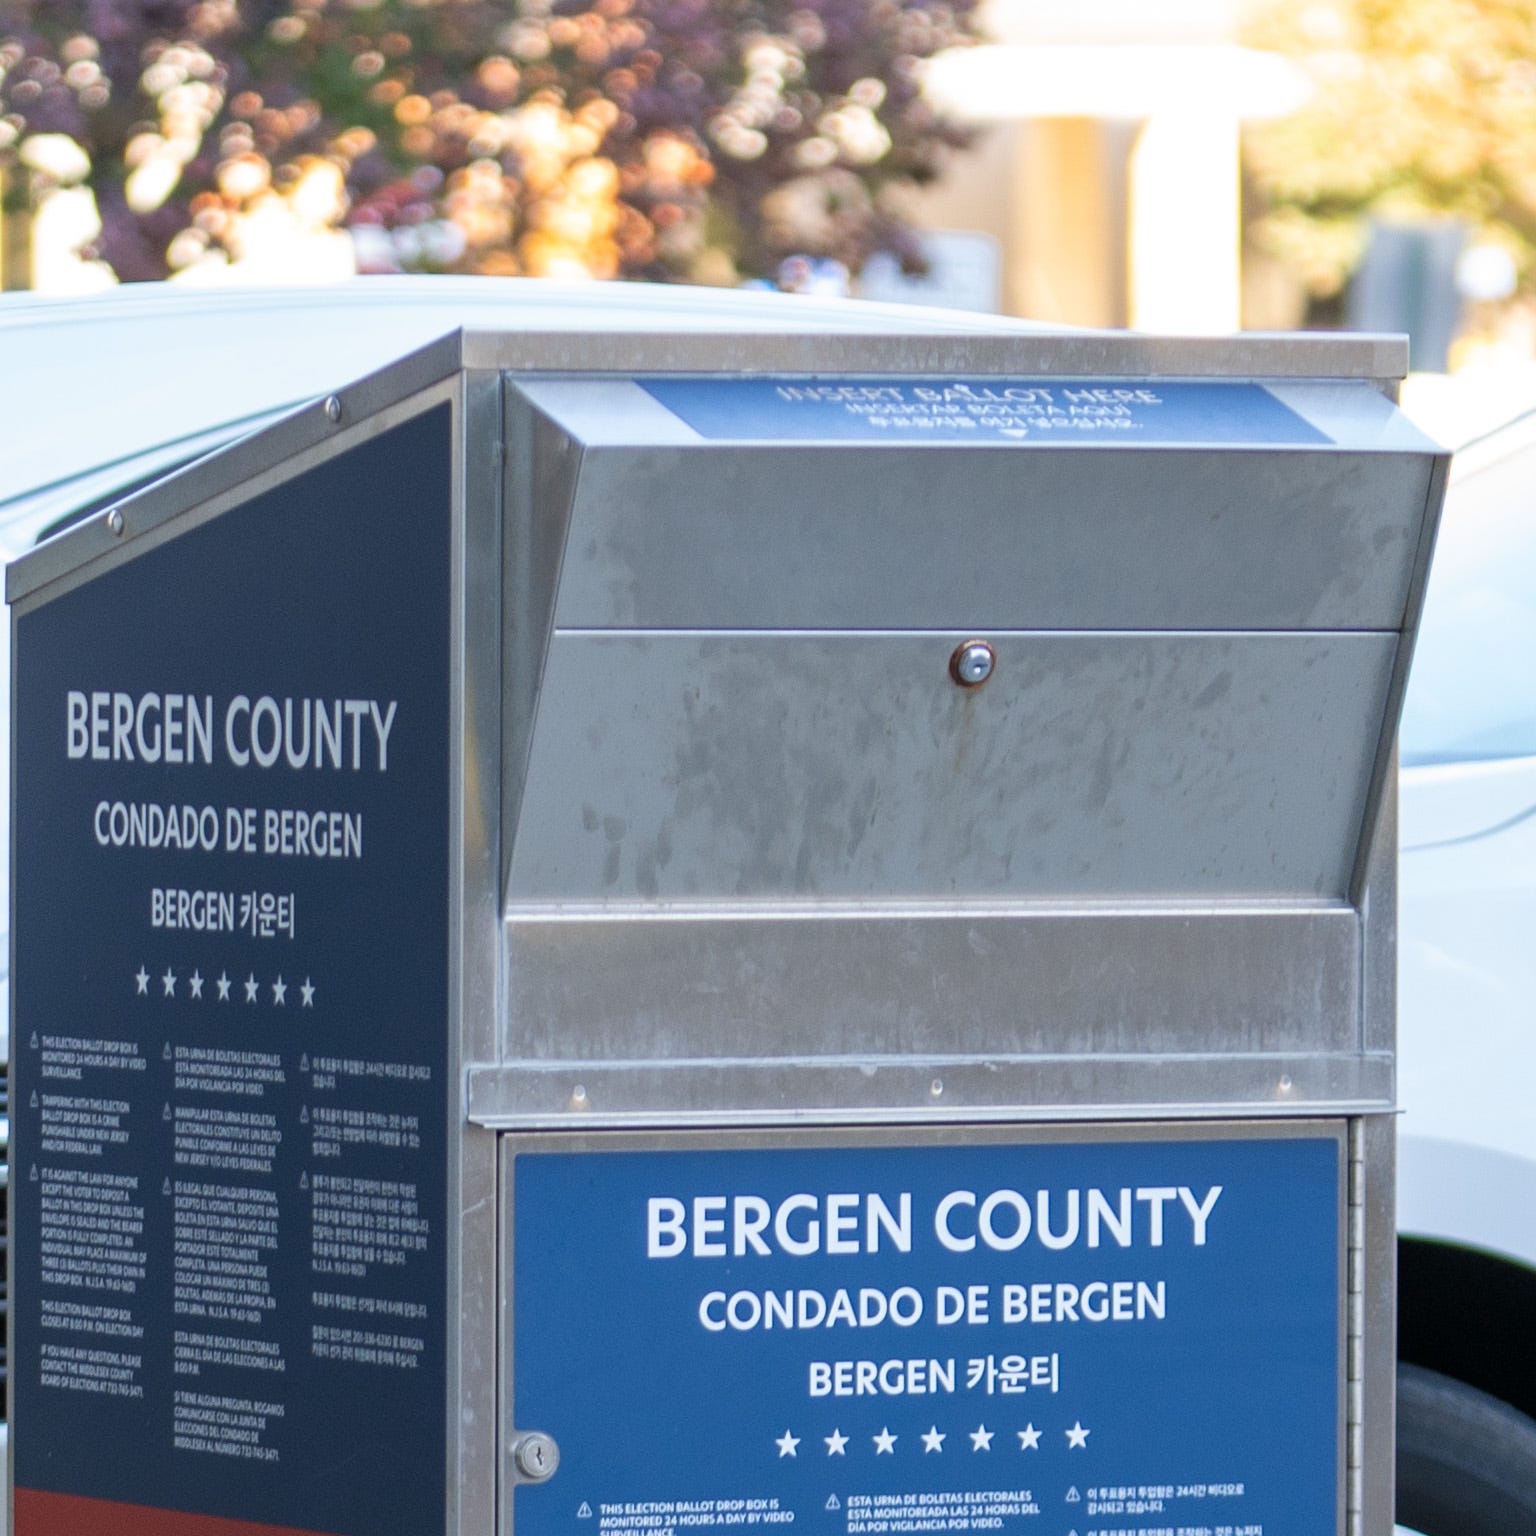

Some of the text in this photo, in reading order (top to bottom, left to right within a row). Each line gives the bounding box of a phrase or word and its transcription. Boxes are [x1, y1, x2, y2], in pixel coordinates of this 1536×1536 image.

[775, 386, 1163, 404] INSERT BALLOT HERE
[845, 402, 962, 414] INSERTAR
[967, 403, 1066, 416] BOLETA
[67, 691, 397, 771] BERGEN COUNTY
[95, 800, 362, 858] CONDADO DE BERGEN
[151, 888, 294, 939] BERGEN 카운티
[646, 1184, 1223, 1259] BERGEN COUNTY
[698, 1280, 1166, 1332] CONDADO DE BERGEN
[809, 1352, 1060, 1398] BERGEN 카운티
[600, 1499, 779, 1514] THIS ELECTION BALLOT DROP BOX IS
[847, 1491, 1032, 1506] ESTA URNA DE BOLETAS ELECTORALES
[600, 1515, 663, 1527] MONITORED
[679, 1514, 715, 1525] HOURS
[716, 1513, 724, 1523] A
[725, 1513, 746, 1523] DAY
[747, 1512, 761, 1523] BY
[763, 1511, 794, 1522] VIDEO
[874, 1506, 949, 1518] MONITOREADA
[950, 1505, 969, 1516] LAS
[985, 1503, 1020, 1515] HORAS
[1021, 1503, 1040, 1514] DEL
[867, 1521, 889, 1532] POR
[890, 1519, 947, 1531] VIGILANCIA
[948, 1518, 970, 1529] POR
